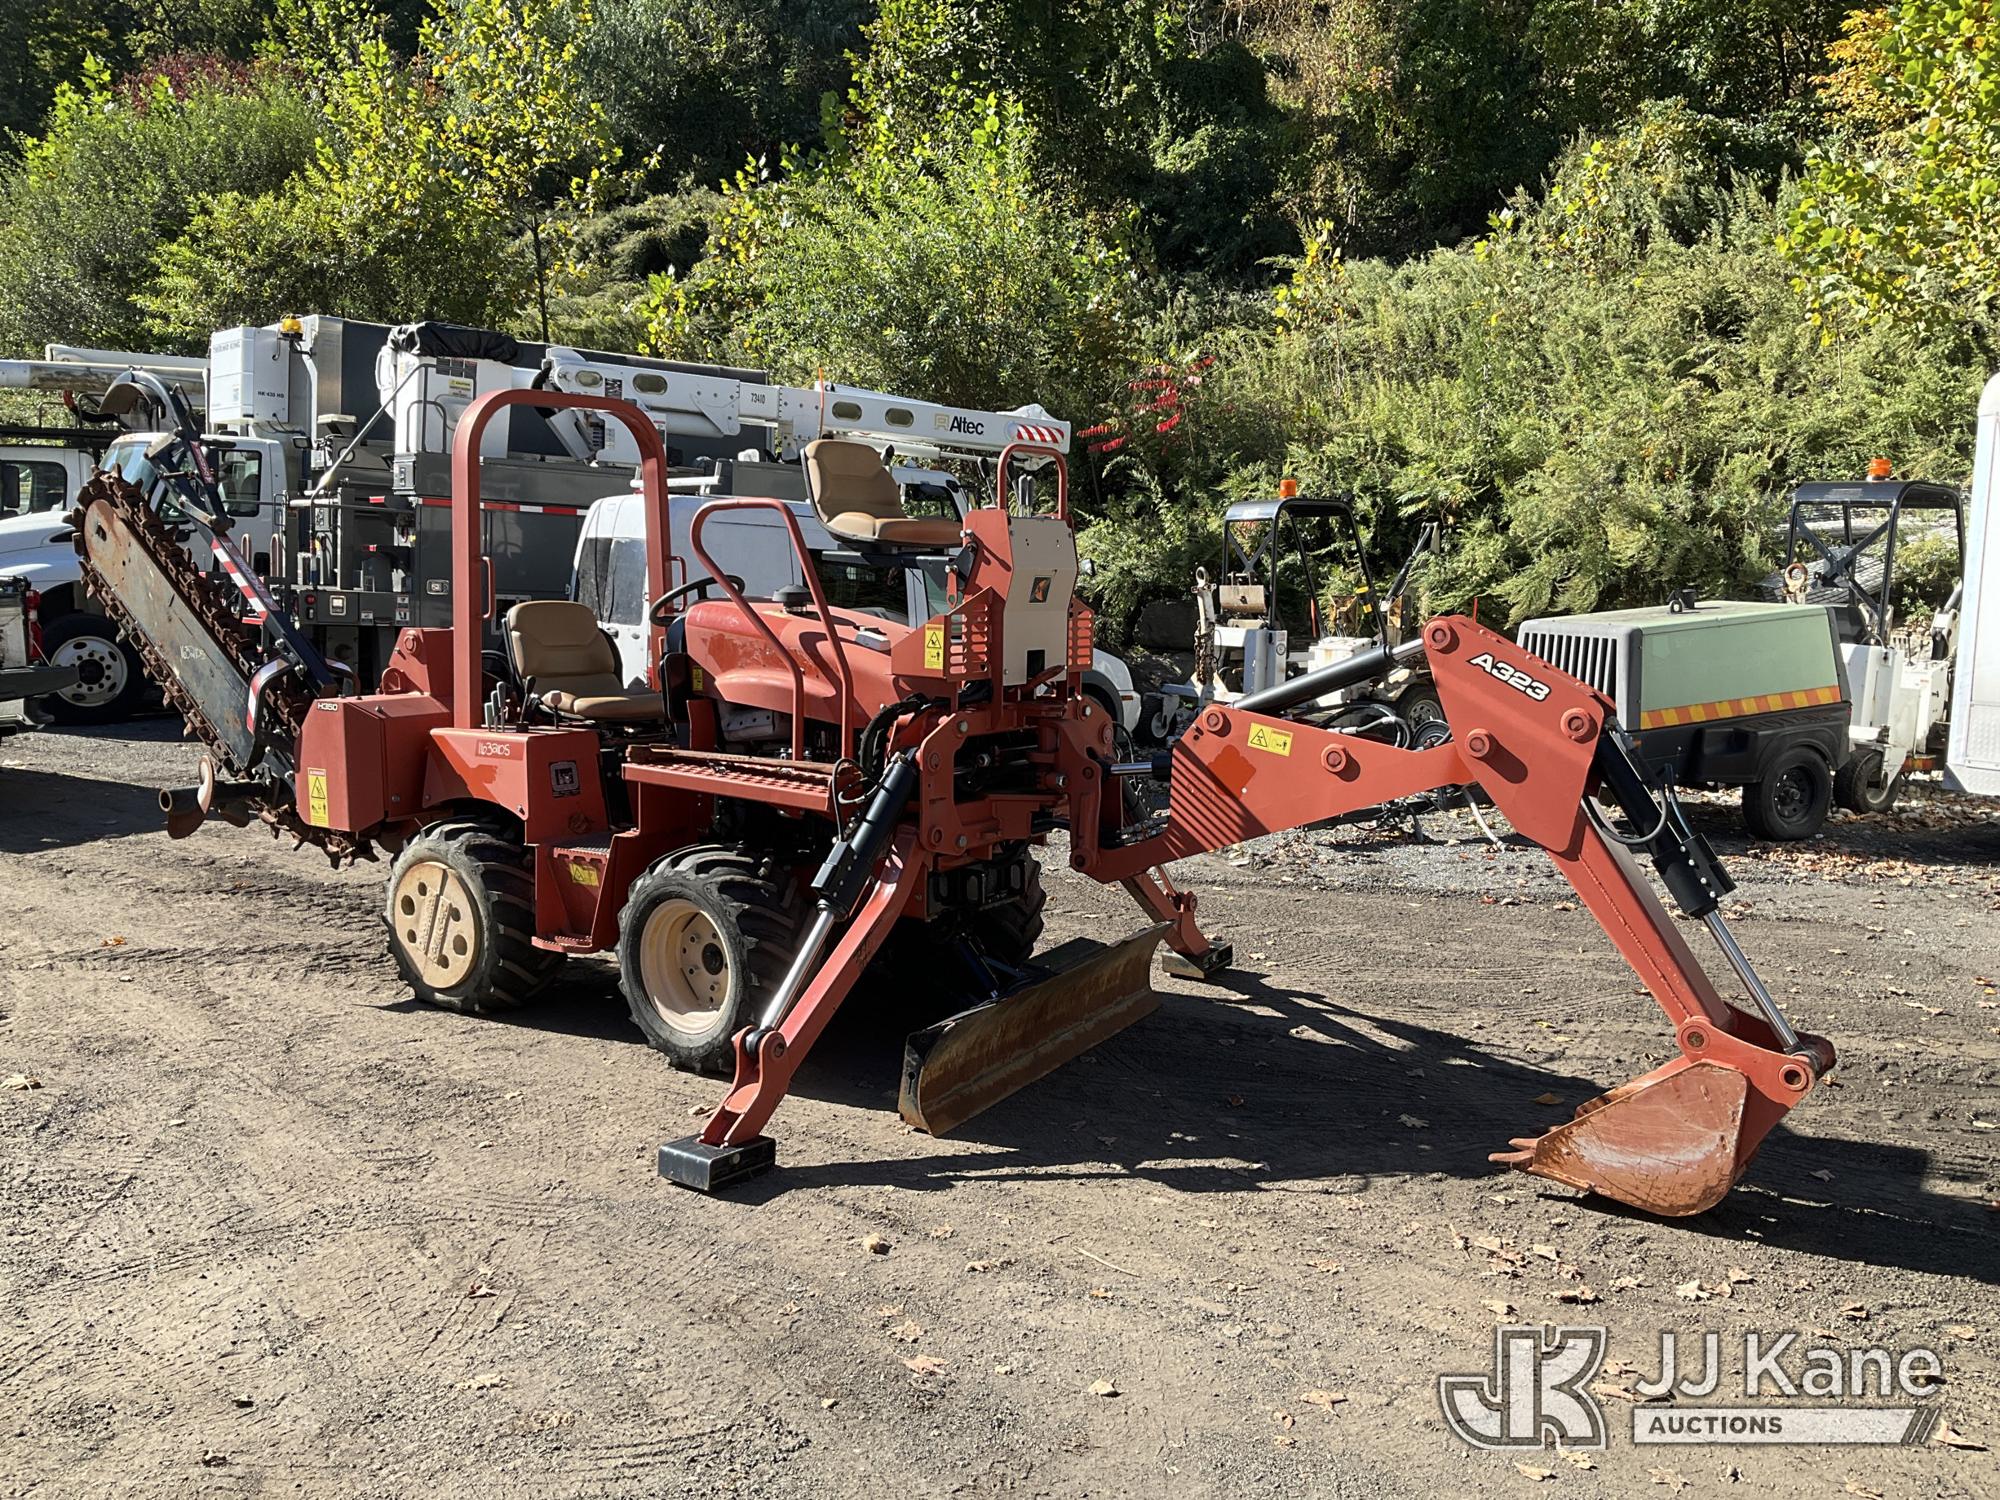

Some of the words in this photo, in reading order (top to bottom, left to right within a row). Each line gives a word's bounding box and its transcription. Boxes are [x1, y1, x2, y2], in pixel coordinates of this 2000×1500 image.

[949, 415, 985, 436] Altec
[1466, 652, 1552, 702] A323
[317, 701, 338, 711] H350
